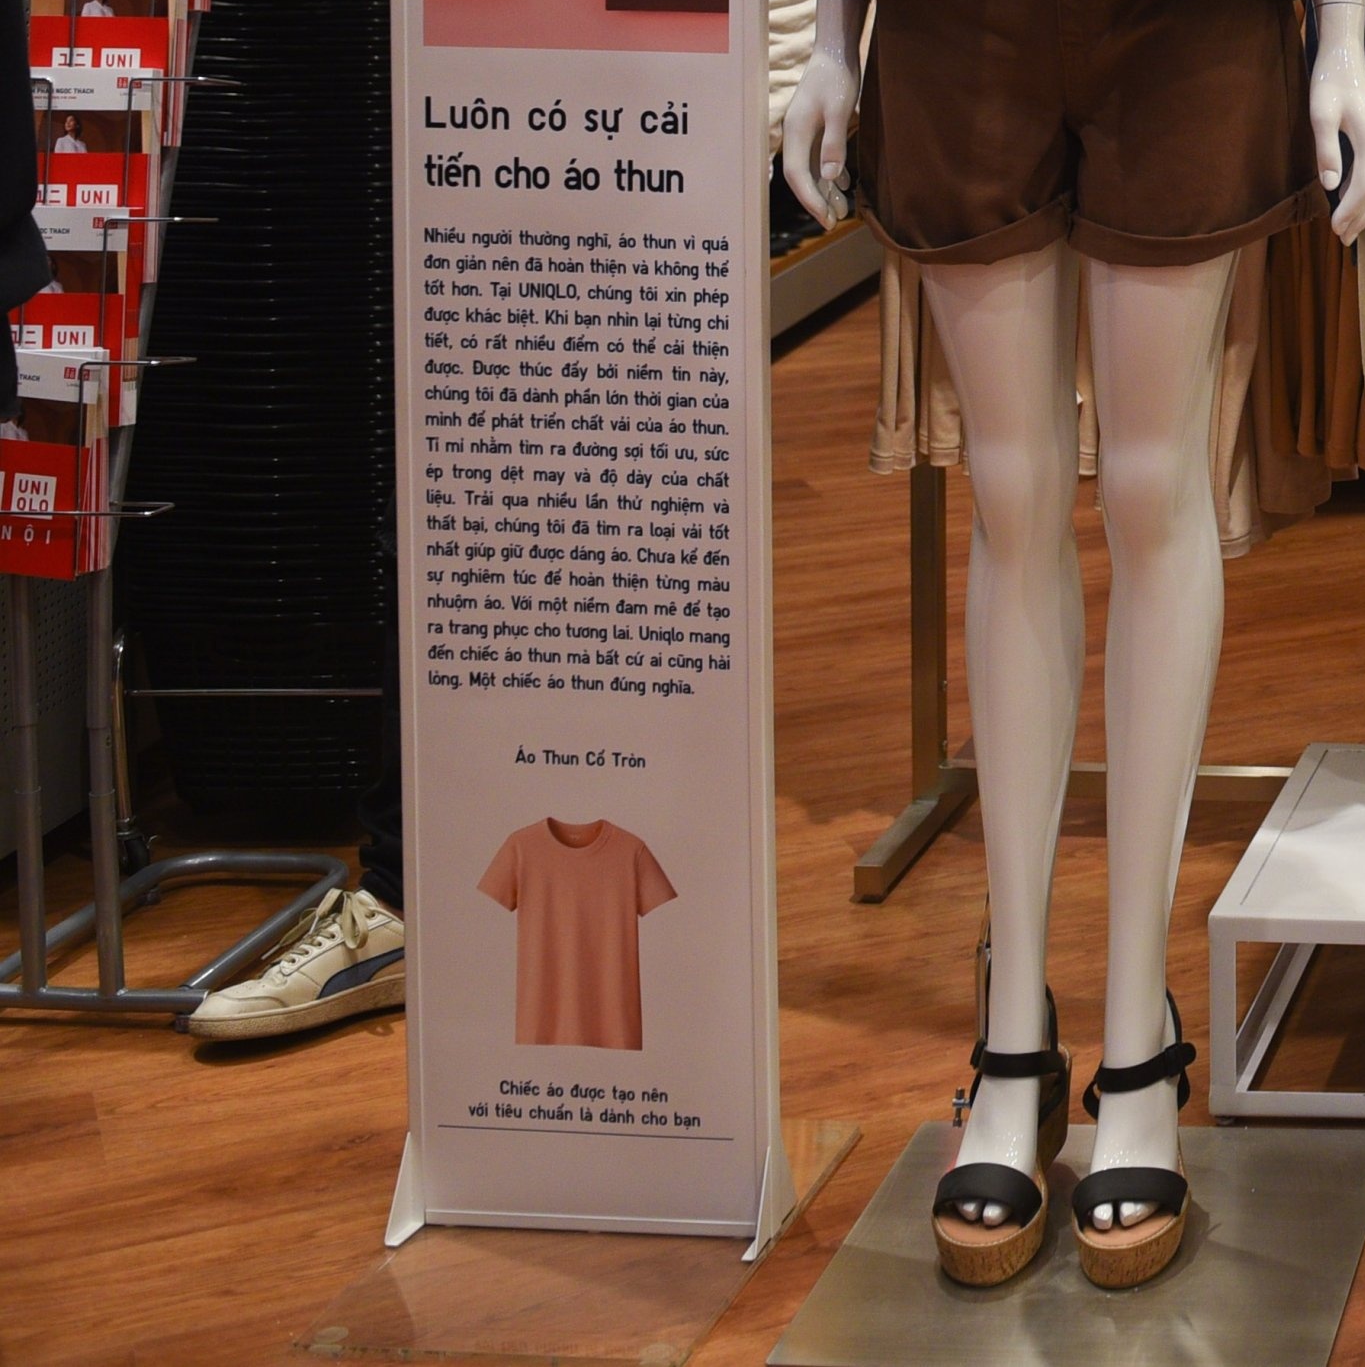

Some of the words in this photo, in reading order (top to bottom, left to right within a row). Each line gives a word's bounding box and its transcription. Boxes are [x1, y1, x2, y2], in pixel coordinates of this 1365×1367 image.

[106, 54, 132, 67] UNI
[425, 96, 510, 130] Luôn
[528, 99, 566, 131] có
[584, 107, 623, 141] sự
[640, 101, 688, 135] cải
[424, 151, 481, 188] tiến
[495, 157, 550, 189] cho
[564, 158, 600, 191] áo
[614, 159, 684, 193] thun
[81, 190, 110, 204] UNI
[452, 281, 482, 297] hơn.
[490, 281, 511, 301] Tại
[519, 282, 580, 301] UNIQLO,
[587, 284, 632, 305] chúng
[639, 286, 658, 301] tôi
[665, 287, 686, 302] xin
[694, 288, 729, 308] phép
[57, 331, 86, 345] UNI
[428, 670, 463, 690] lòng.
[547, 674, 565, 689] áo
[571, 675, 604, 691] thun
[610, 676, 646, 696] đúng
[515, 745, 536, 764] Áo
[542, 749, 579, 765] Thun
[612, 752, 646, 768] Tròn
[546, 1082, 564, 1097] áo
[570, 1083, 605, 1102] được
[612, 1085, 635, 1104] tạo
[642, 1088, 668, 1103] nên
[468, 1102, 488, 1117] với
[495, 1103, 522, 1119] tiêu
[580, 1107, 593, 1122] là
[599, 1108, 635, 1124] dành
[641, 1111, 668, 1126] cho
[674, 1112, 701, 1130] bạn
